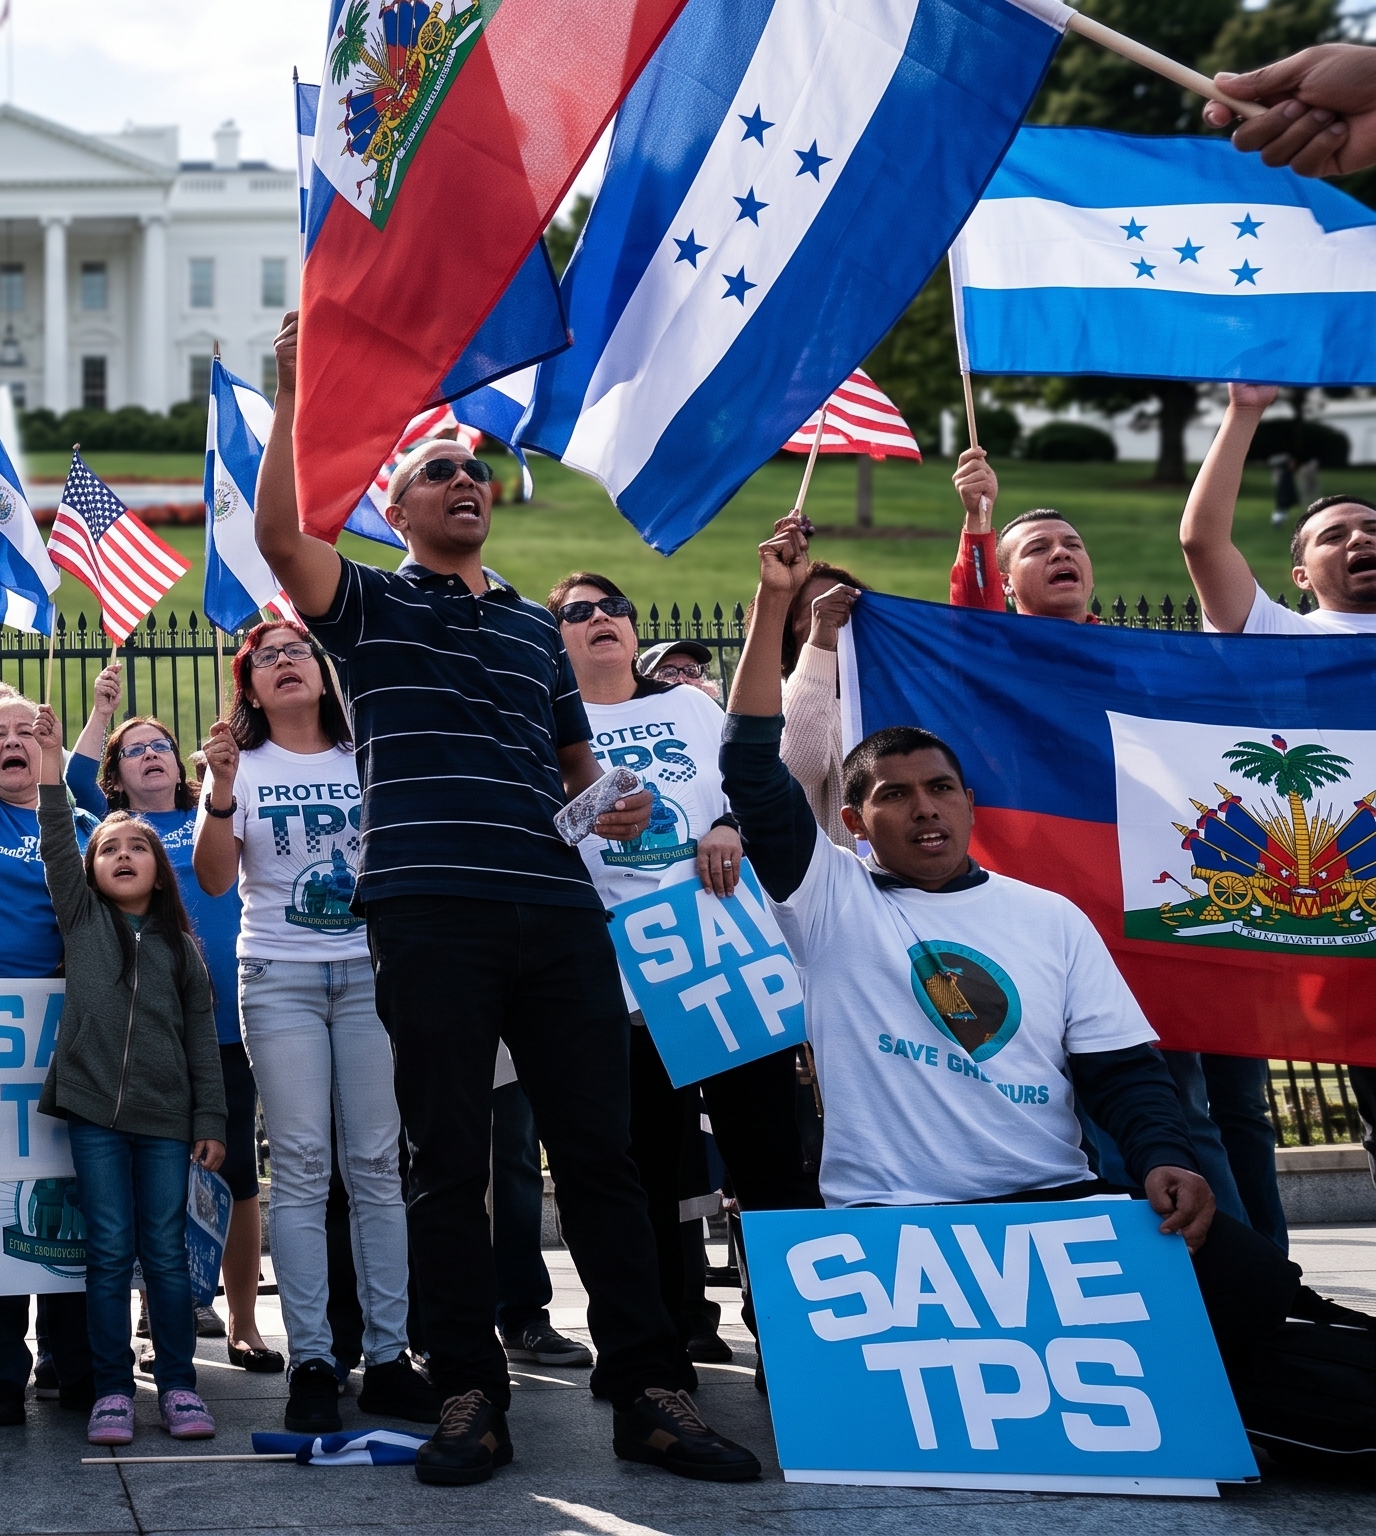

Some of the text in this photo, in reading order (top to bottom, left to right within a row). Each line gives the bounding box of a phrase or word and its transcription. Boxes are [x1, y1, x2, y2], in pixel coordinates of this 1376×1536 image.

[589, 722, 675, 748] OTECT
[595, 739, 697, 782] PS
[258, 783, 360, 802] PROTEC
[624, 876, 784, 984] SAV
[678, 954, 803, 1053] TP
[878, 1033, 939, 1067] SAVE
[786, 1214, 1151, 1342] SAVE
[861, 1337, 1162, 1452] TPS
